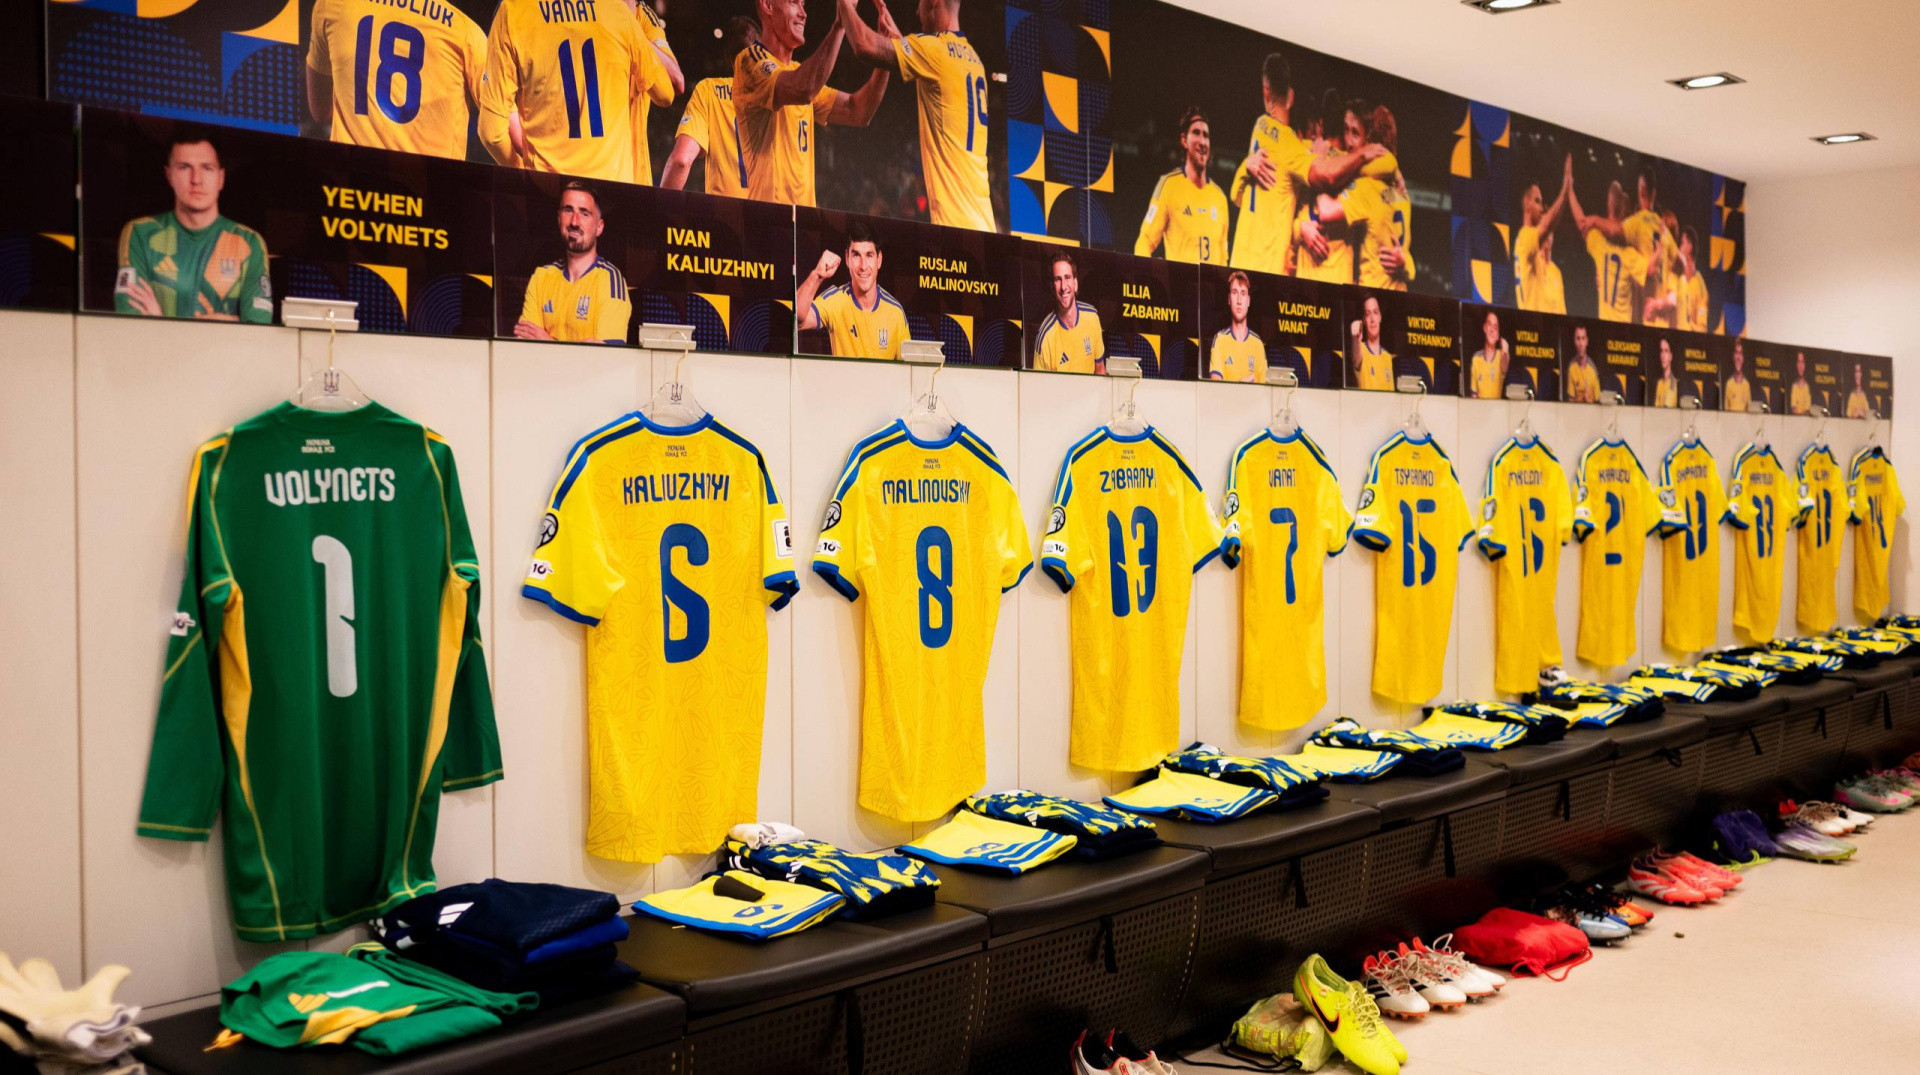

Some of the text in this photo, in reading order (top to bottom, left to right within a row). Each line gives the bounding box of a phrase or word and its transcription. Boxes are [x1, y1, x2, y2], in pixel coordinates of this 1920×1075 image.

[538, 0, 598, 24] VANAT
[354, 14, 426, 125] 18
[558, 37, 604, 139] 11
[798, 119, 808, 152] 15
[322, 185, 423, 218] YEVHEN
[322, 215, 449, 250] VOLYNETS
[666, 226, 711, 249] IVAN
[666, 253, 775, 281] KALIUZHNYI
[919, 255, 968, 275] RUSLAN
[919, 274, 999, 296] MALINOVSKYI
[1122, 282, 1151, 300] ILLIA
[1122, 302, 1179, 323] ZABARNYI
[1278, 301, 1331, 320] VLADYSLAV
[1278, 319, 1309, 335] VANAT
[1407, 316, 1436, 331] VIKTOR
[1406, 332, 1453, 349] TSYHANKOV
[265, 467, 396, 507] VOLYNETS
[1269, 507, 1299, 605] 7
[1399, 498, 1437, 588] 15
[1106, 505, 1159, 618] 13
[659, 522, 710, 664] 6
[915, 525, 954, 649] 8
[311, 534, 358, 698] 1
